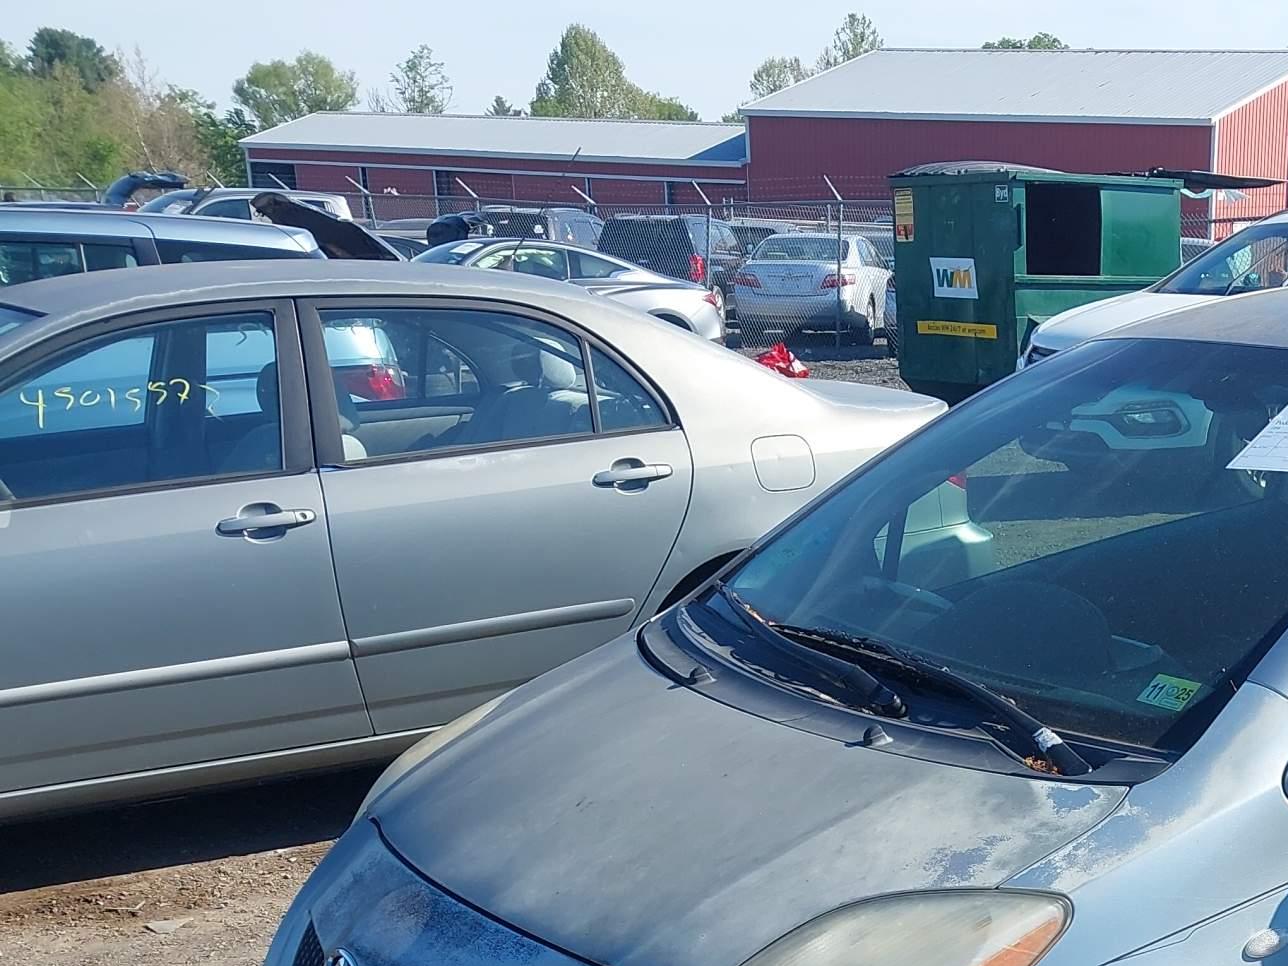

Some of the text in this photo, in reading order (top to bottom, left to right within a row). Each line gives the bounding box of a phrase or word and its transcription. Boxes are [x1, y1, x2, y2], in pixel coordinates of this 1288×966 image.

[936, 268, 972, 289] WM
[1146, 682, 1195, 701] 11 25
